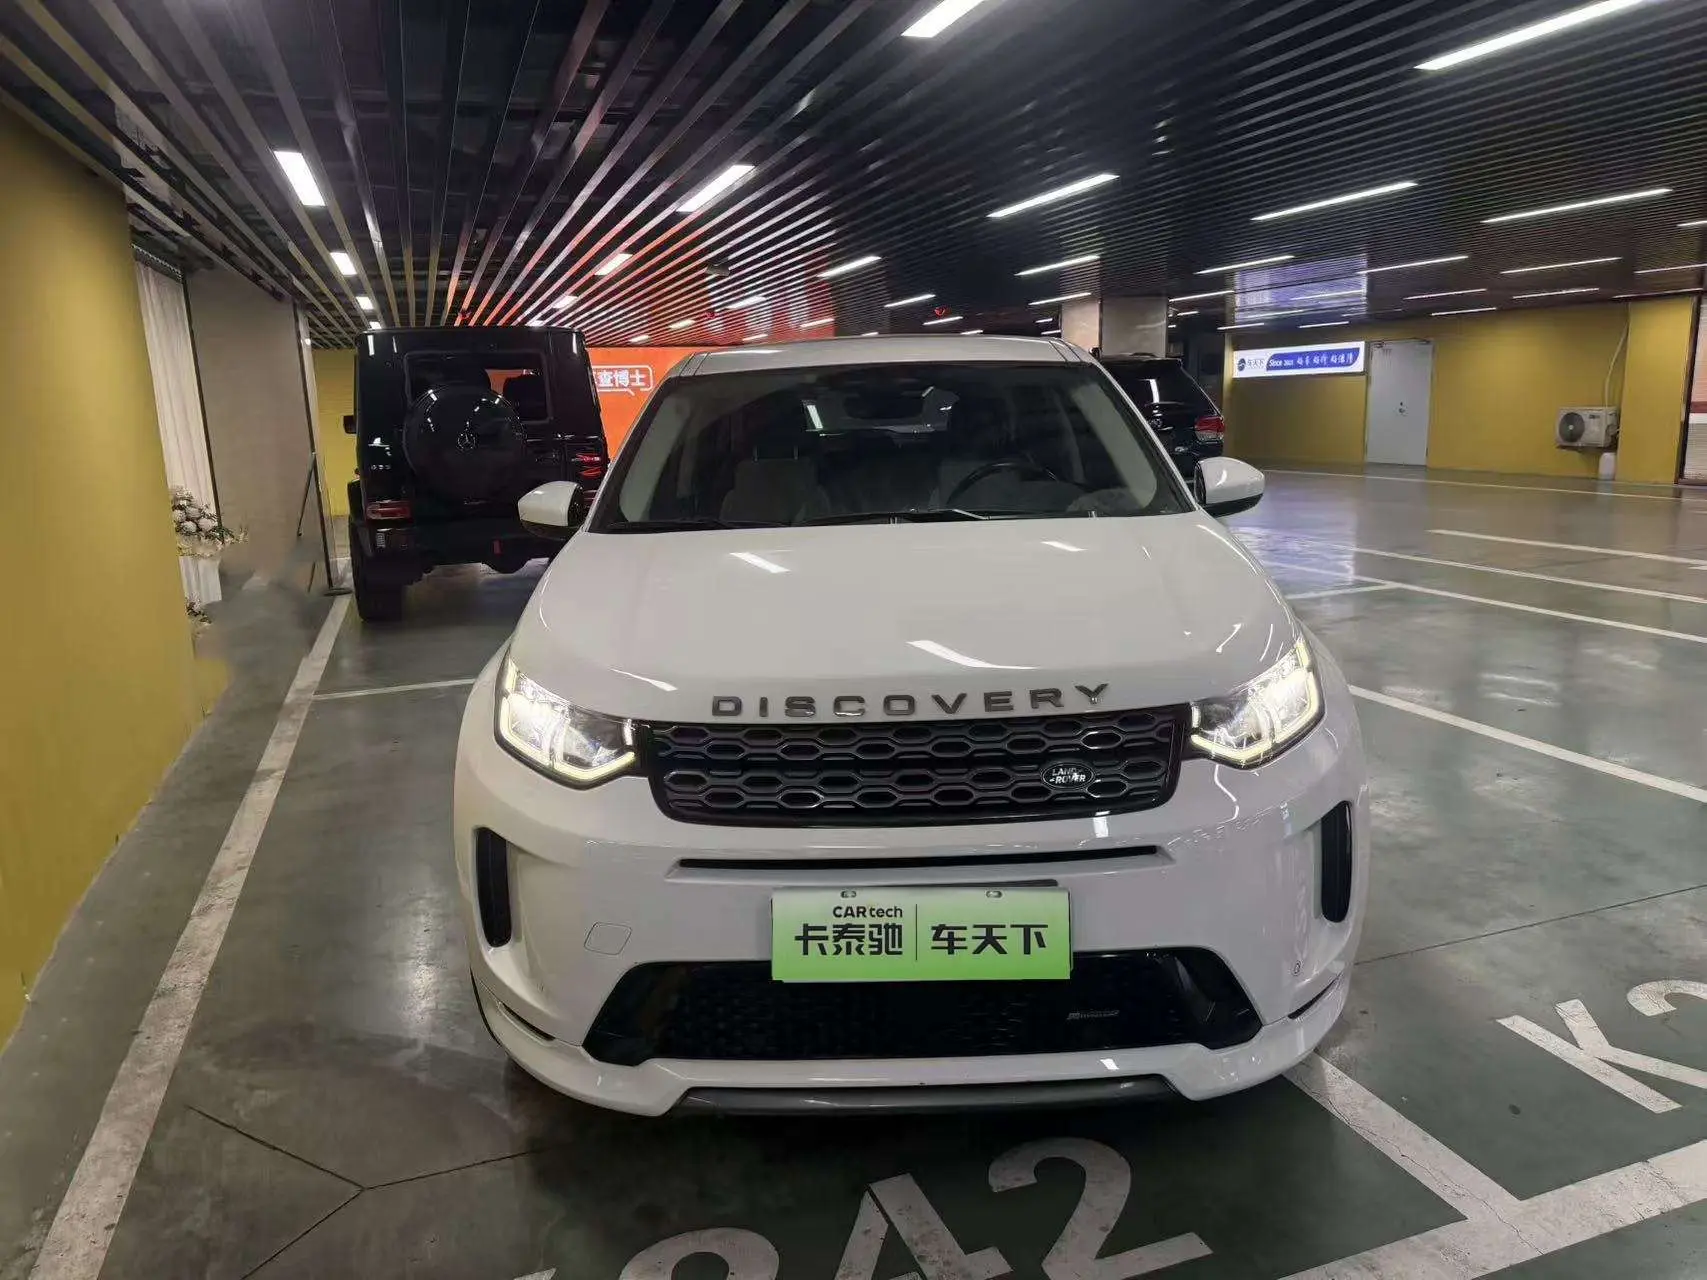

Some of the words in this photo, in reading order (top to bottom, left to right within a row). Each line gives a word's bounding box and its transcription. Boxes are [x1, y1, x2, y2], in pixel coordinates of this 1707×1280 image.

[593, 369, 646, 388] 查博士
[711, 683, 1109, 717] DISCOVERY
[1052, 767, 1077, 776] LAND
[1055, 773, 1086, 784] ROVER
[794, 923, 904, 956] 卡泰驰
[931, 923, 1049, 955] 车天下
